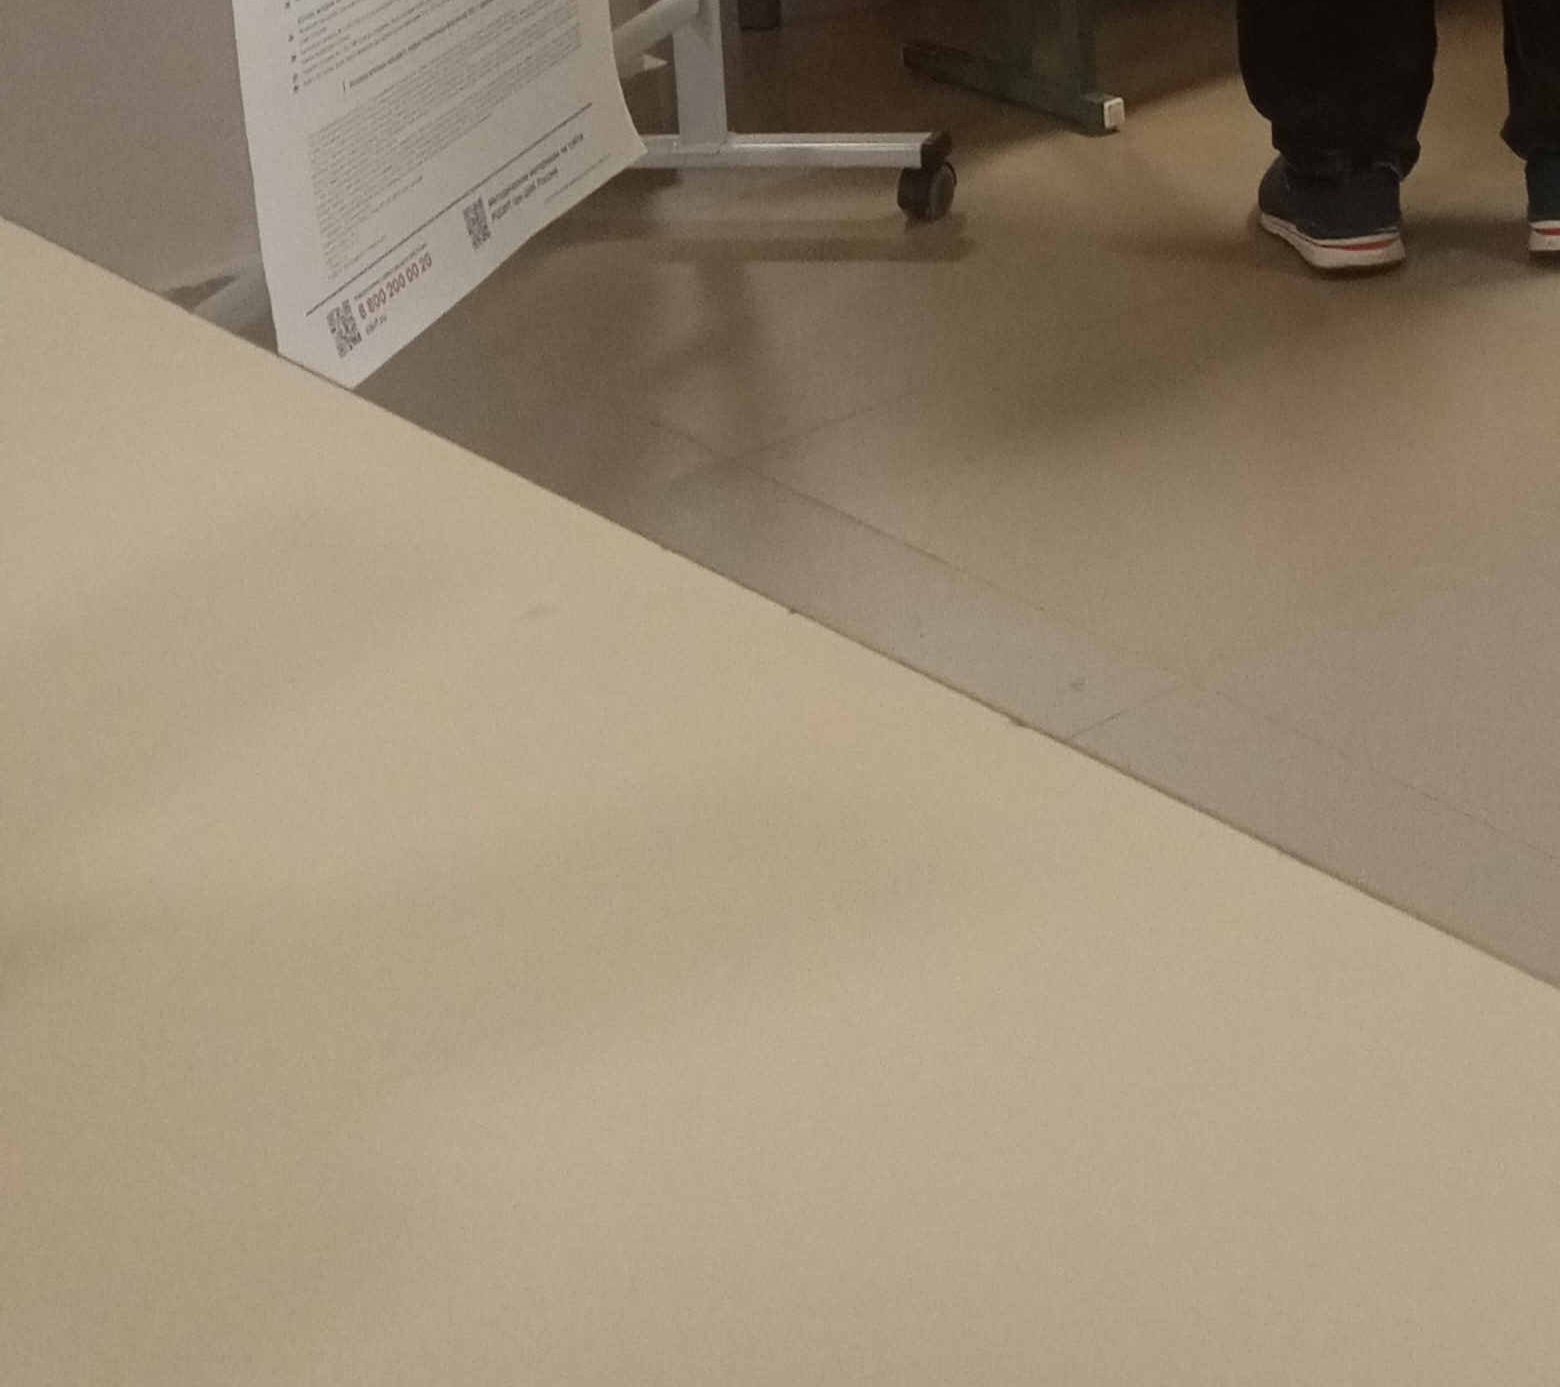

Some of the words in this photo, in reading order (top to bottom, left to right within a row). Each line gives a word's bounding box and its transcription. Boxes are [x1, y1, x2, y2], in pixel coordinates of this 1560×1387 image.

[386, 272, 407, 300] 200
[404, 262, 420, 285] 00
[418, 250, 433, 276] 20
